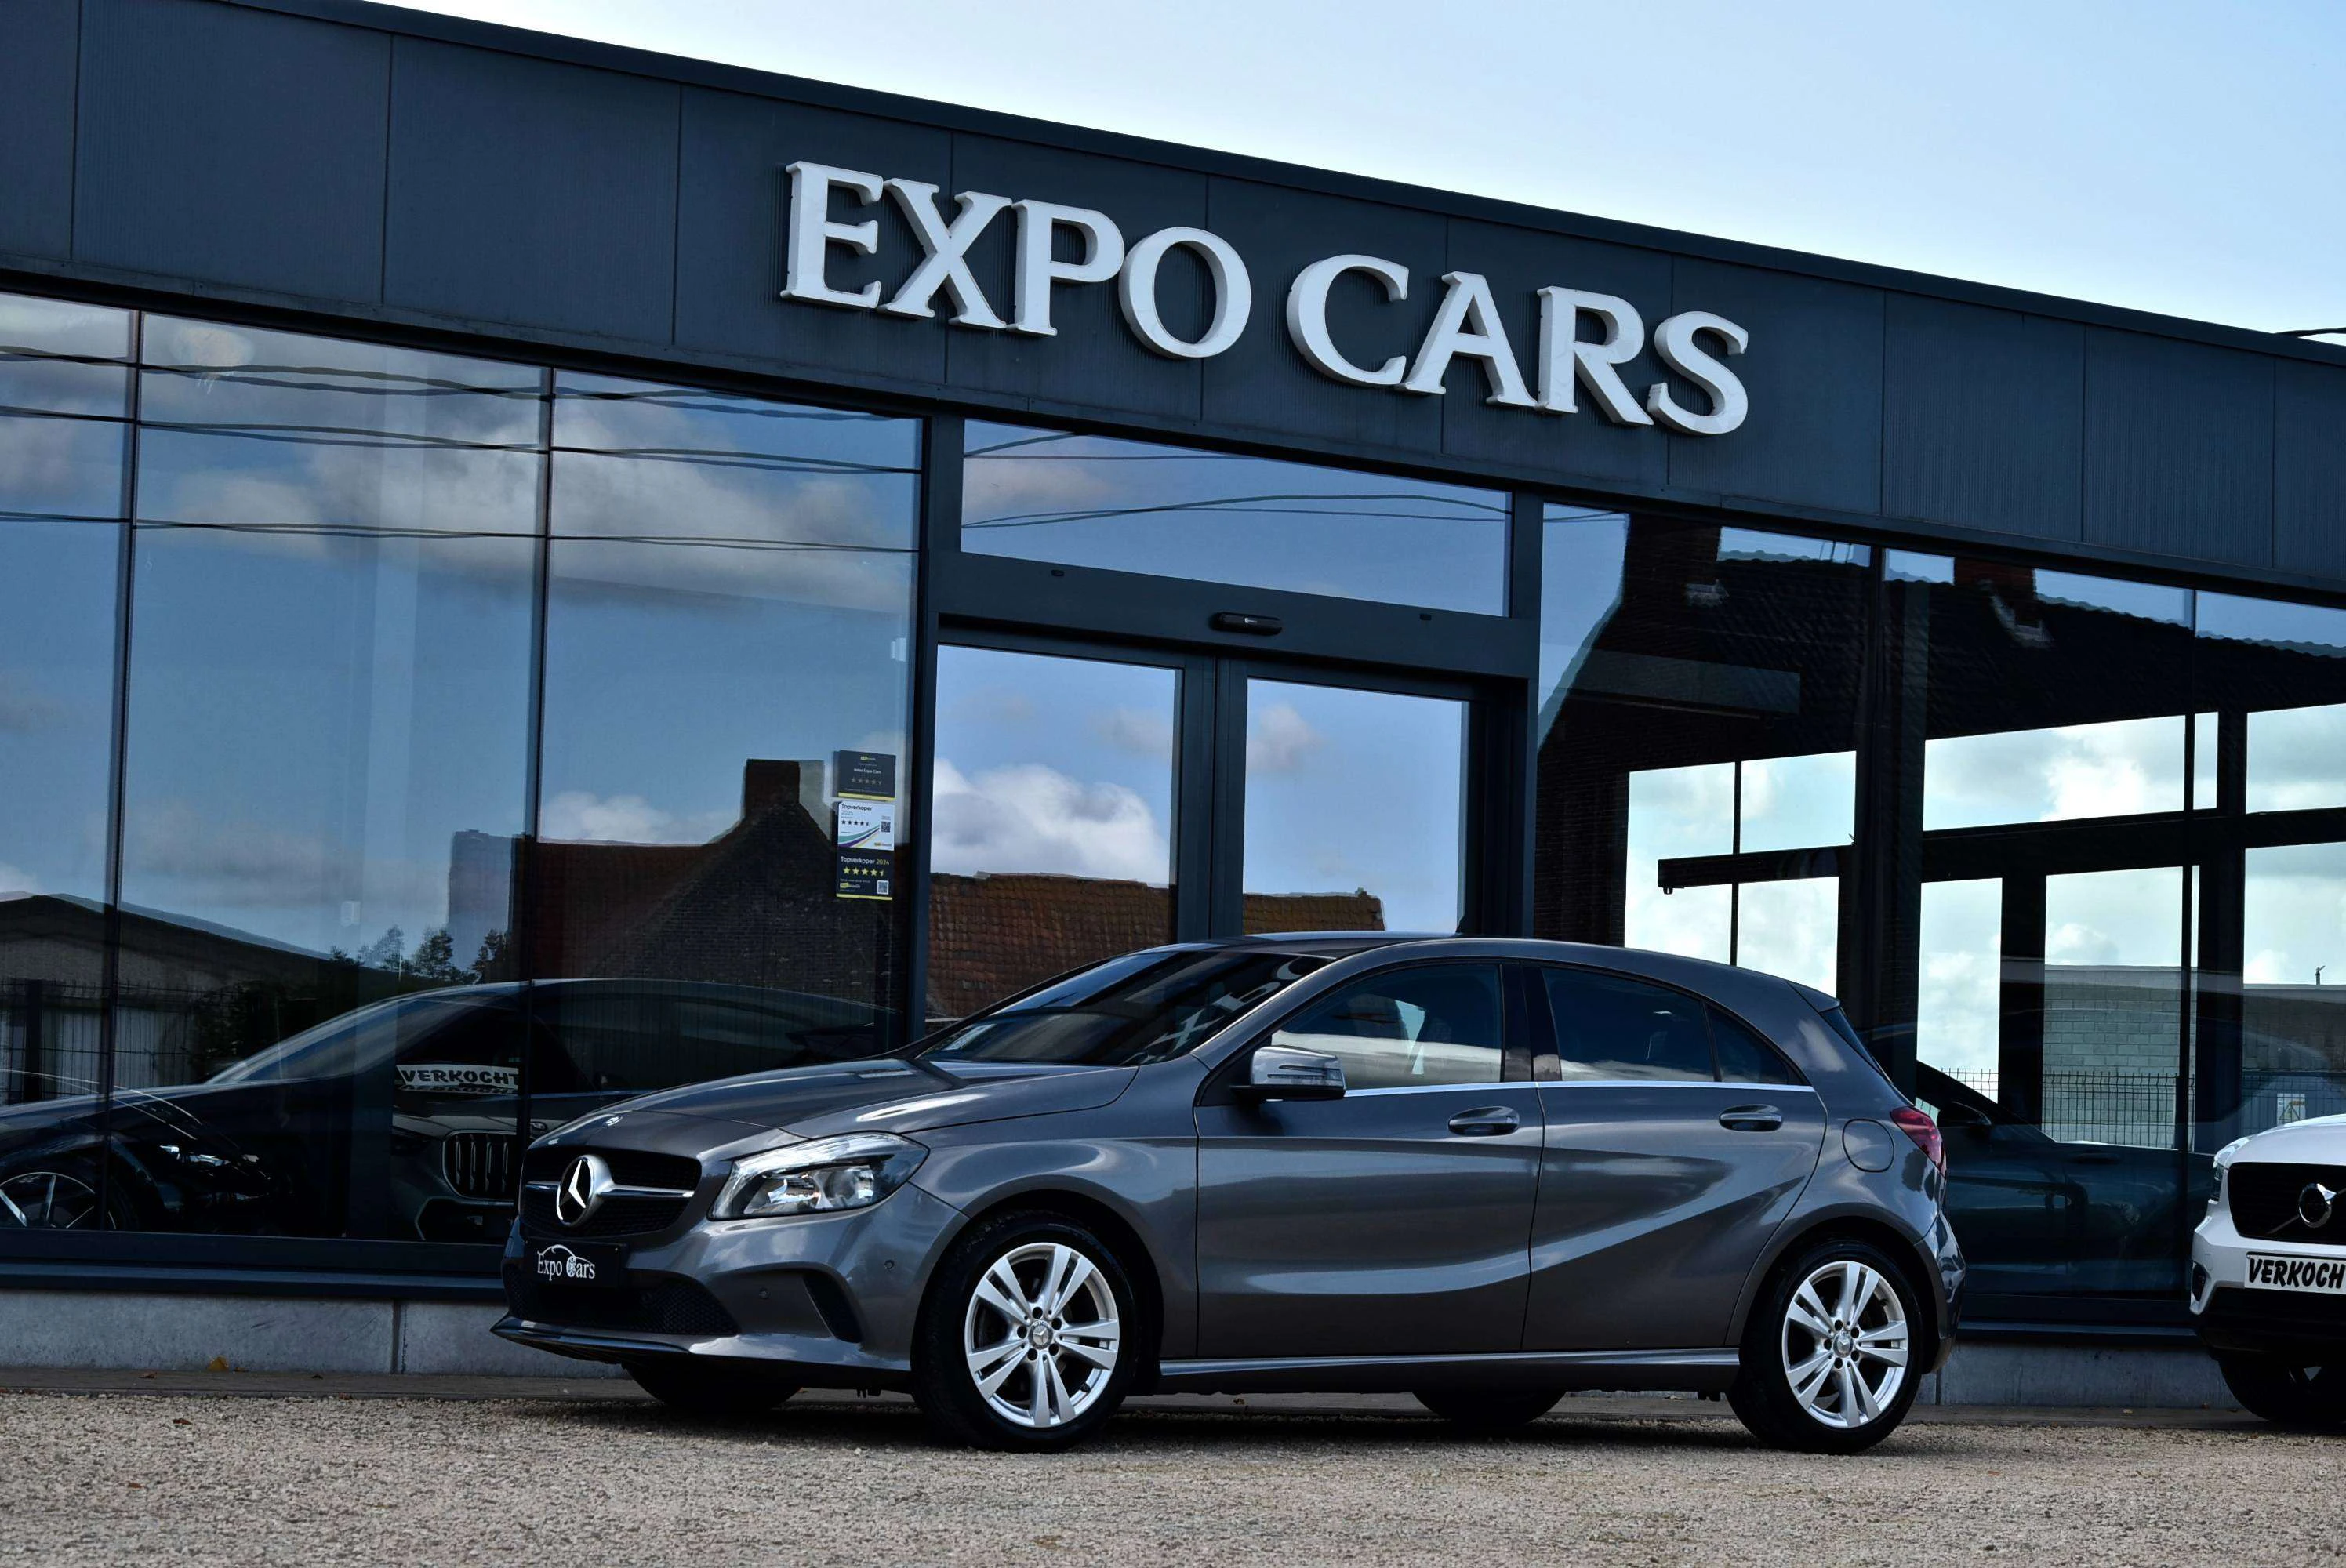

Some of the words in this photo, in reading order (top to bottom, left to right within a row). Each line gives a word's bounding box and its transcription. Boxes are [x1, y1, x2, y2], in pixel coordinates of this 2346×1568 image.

[780, 161, 1251, 358] EXPO
[1287, 254, 1749, 436] CARS
[841, 803, 873, 811] Topverkoper
[841, 855, 875, 865] Topverkoper
[401, 1069, 519, 1086] VERKOCHT
[537, 1251, 563, 1281] Expo
[566, 1256, 595, 1279] Cars
